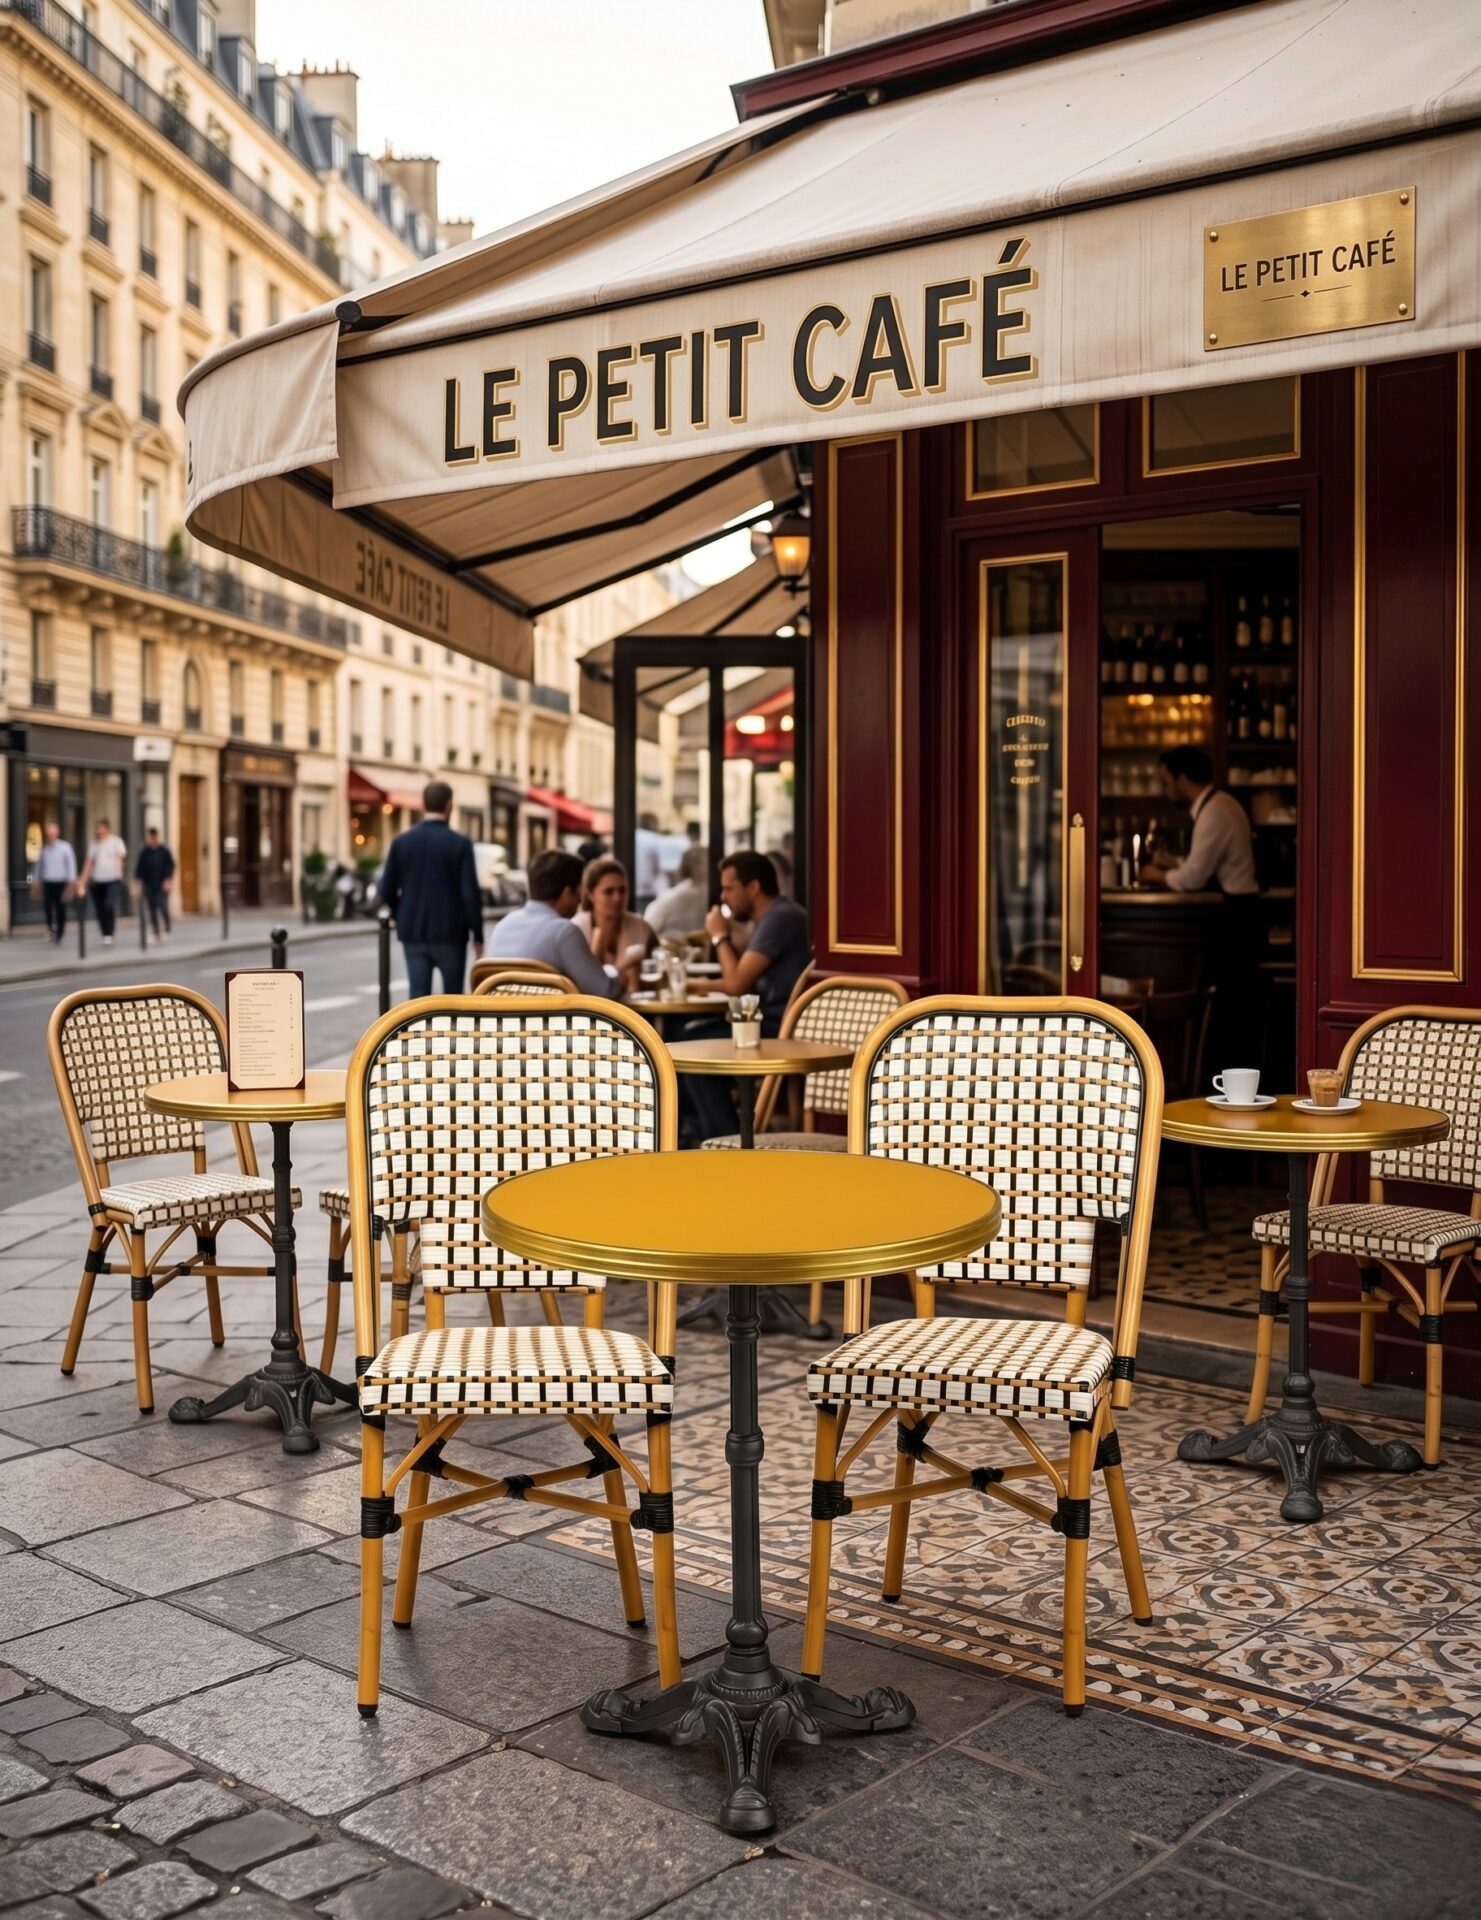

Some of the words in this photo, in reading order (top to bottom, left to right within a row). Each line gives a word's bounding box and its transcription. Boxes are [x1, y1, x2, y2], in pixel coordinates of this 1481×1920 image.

[1221, 263, 1248, 292] LE
[1256, 249, 1324, 287] PETIT
[1331, 229, 1396, 273] CAFÉ
[444, 365, 520, 467] LE
[546, 319, 766, 452] PETIT
[792, 235, 1039, 412] CAFÉ
